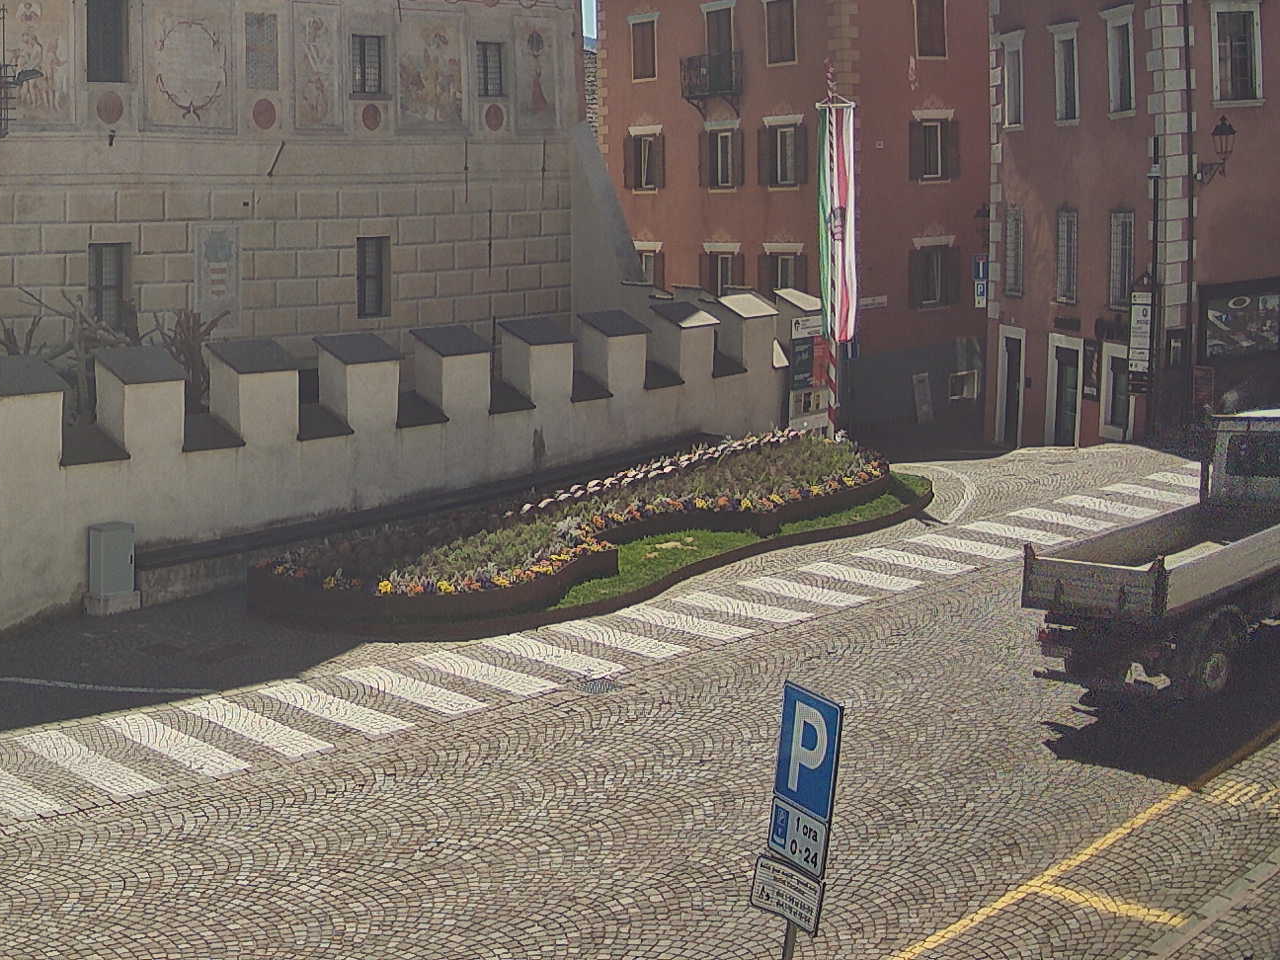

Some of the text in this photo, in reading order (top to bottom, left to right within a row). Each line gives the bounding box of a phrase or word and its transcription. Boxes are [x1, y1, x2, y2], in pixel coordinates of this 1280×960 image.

[788, 700, 828, 793] P
[795, 816, 819, 842] 1 ora
[789, 839, 819, 869] 0-24
